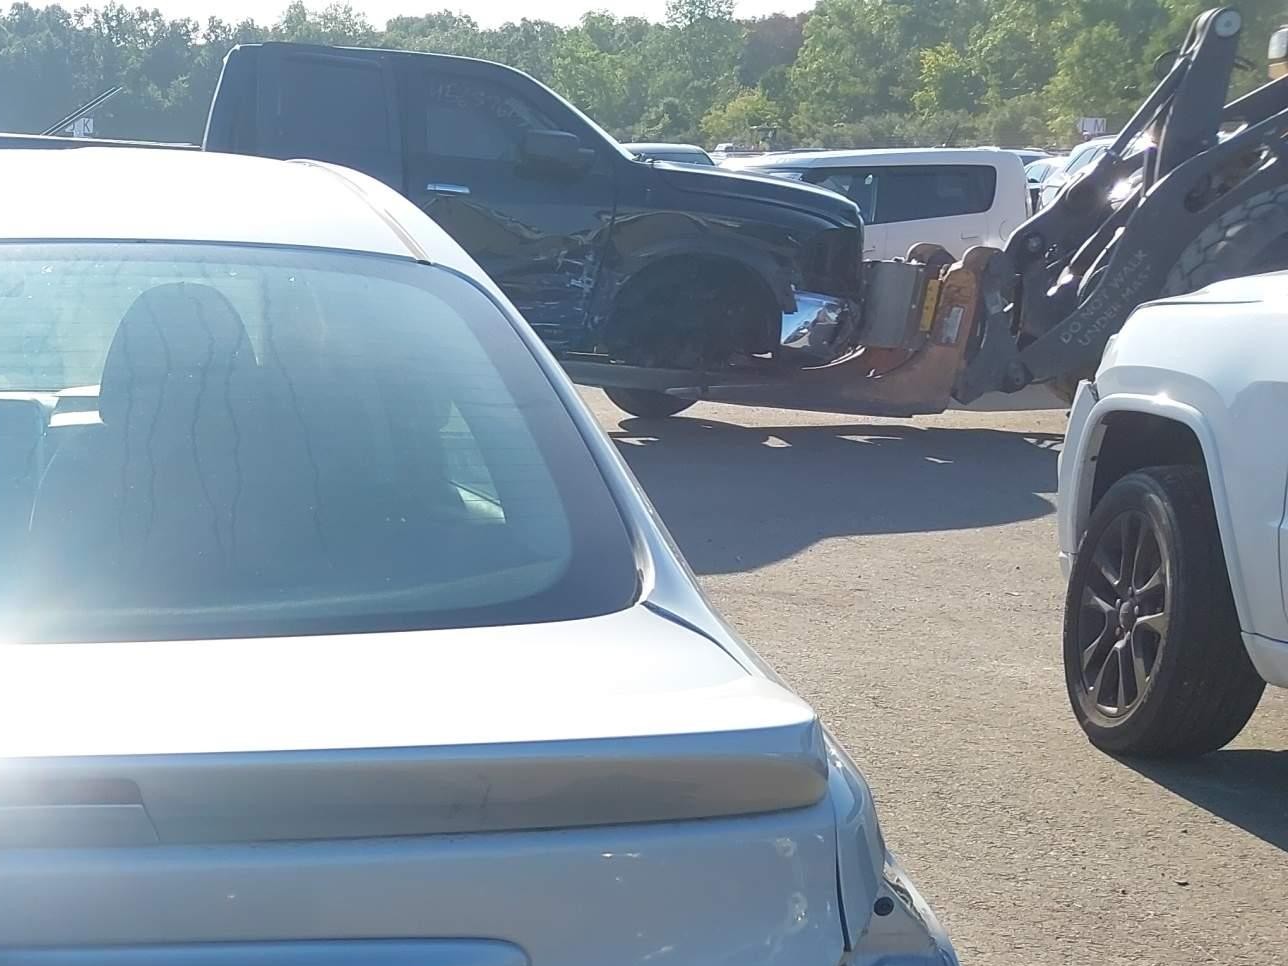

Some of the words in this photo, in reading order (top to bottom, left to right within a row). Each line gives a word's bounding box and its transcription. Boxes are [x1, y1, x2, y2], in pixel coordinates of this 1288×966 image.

[83, 118, 91, 132] K
[1060, 321, 1081, 344] DO
[1080, 286, 1109, 318] NOT
[1108, 250, 1148, 289] WALK
